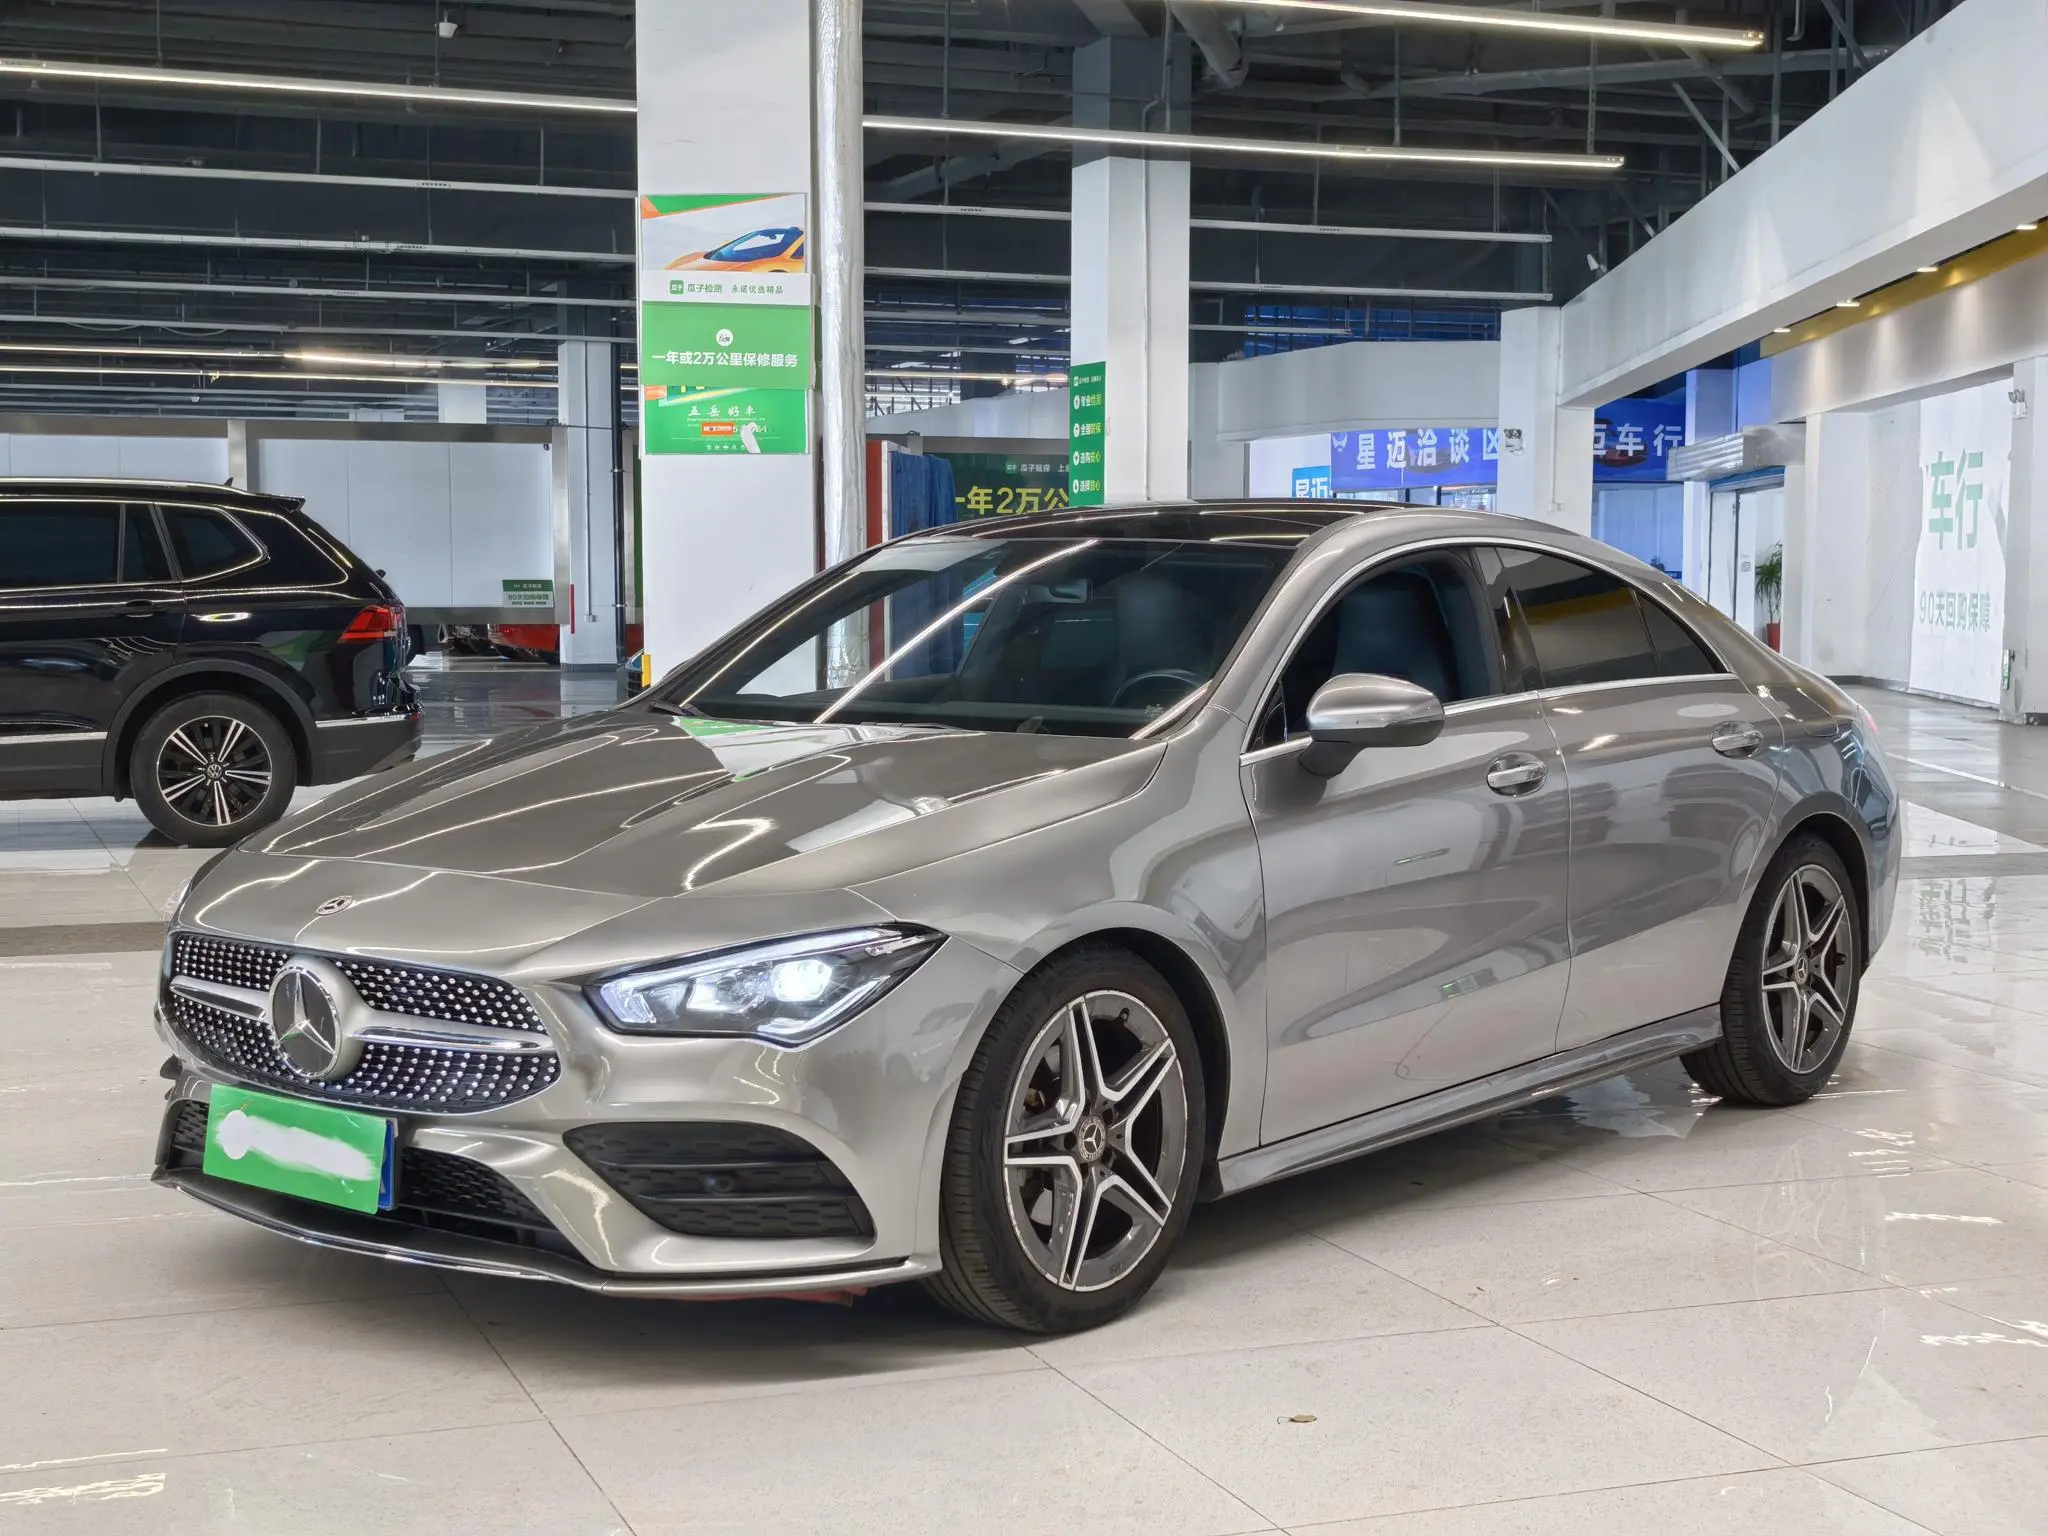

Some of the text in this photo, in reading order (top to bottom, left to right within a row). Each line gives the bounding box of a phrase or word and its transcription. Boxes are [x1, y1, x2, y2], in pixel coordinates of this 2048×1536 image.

[687, 283, 723, 293] 瓜子检测
[652, 351, 798, 367] 一年或2万公里保修服务
[1356, 428, 1500, 470] 星迈洽谈区
[1929, 449, 1983, 550] 车行
